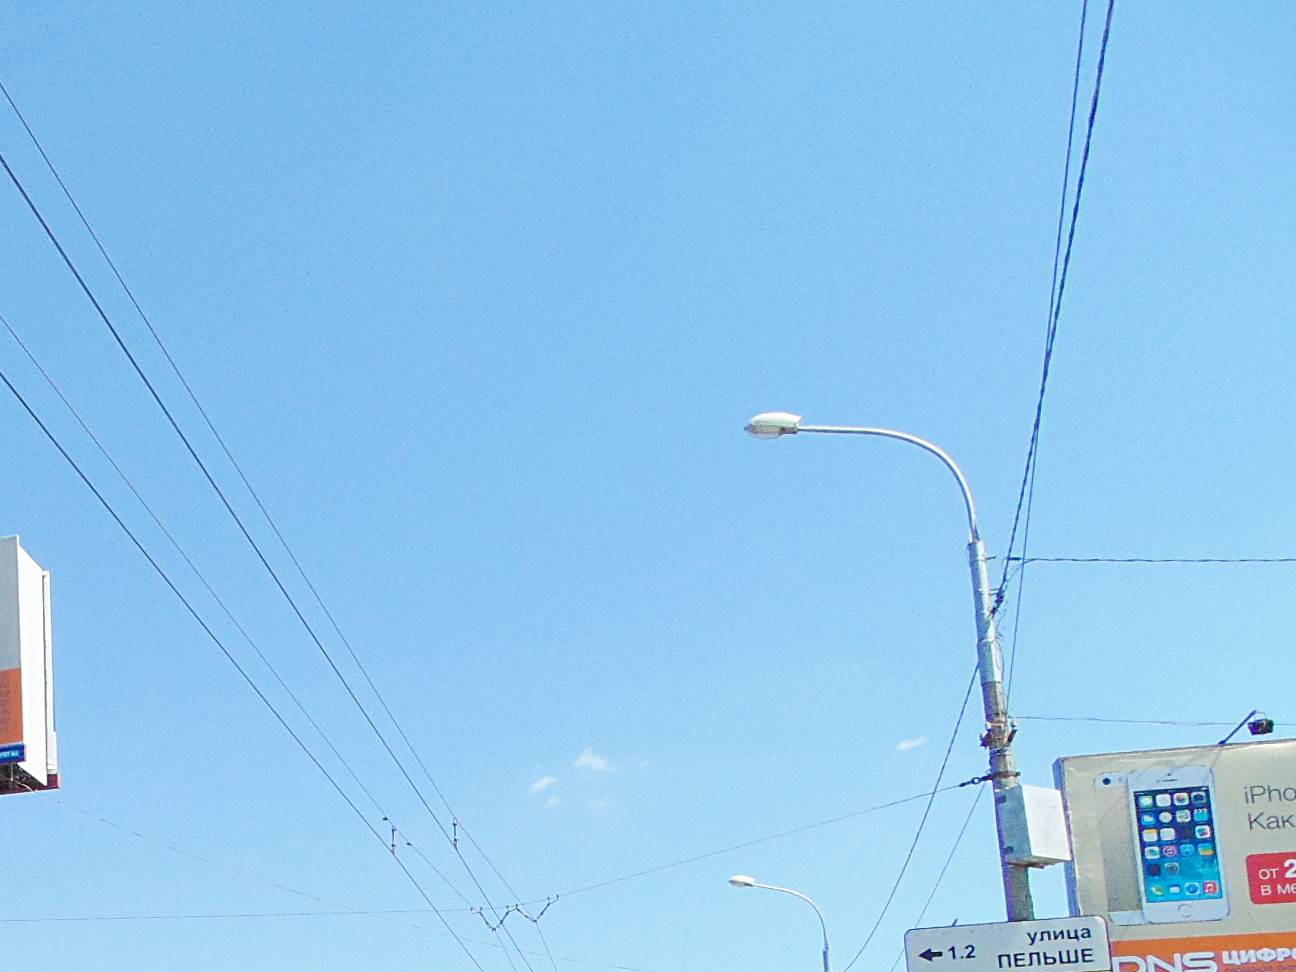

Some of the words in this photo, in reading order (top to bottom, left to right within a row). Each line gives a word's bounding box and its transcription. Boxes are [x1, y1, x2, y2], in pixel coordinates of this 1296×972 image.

[1258, 868, 1279, 880] от
[1260, 885, 1272, 896] в
[1027, 927, 1092, 945] улица
[947, 944, 976, 960] 1.2
[997, 948, 1094, 969] ПЕЛЬШЕ
